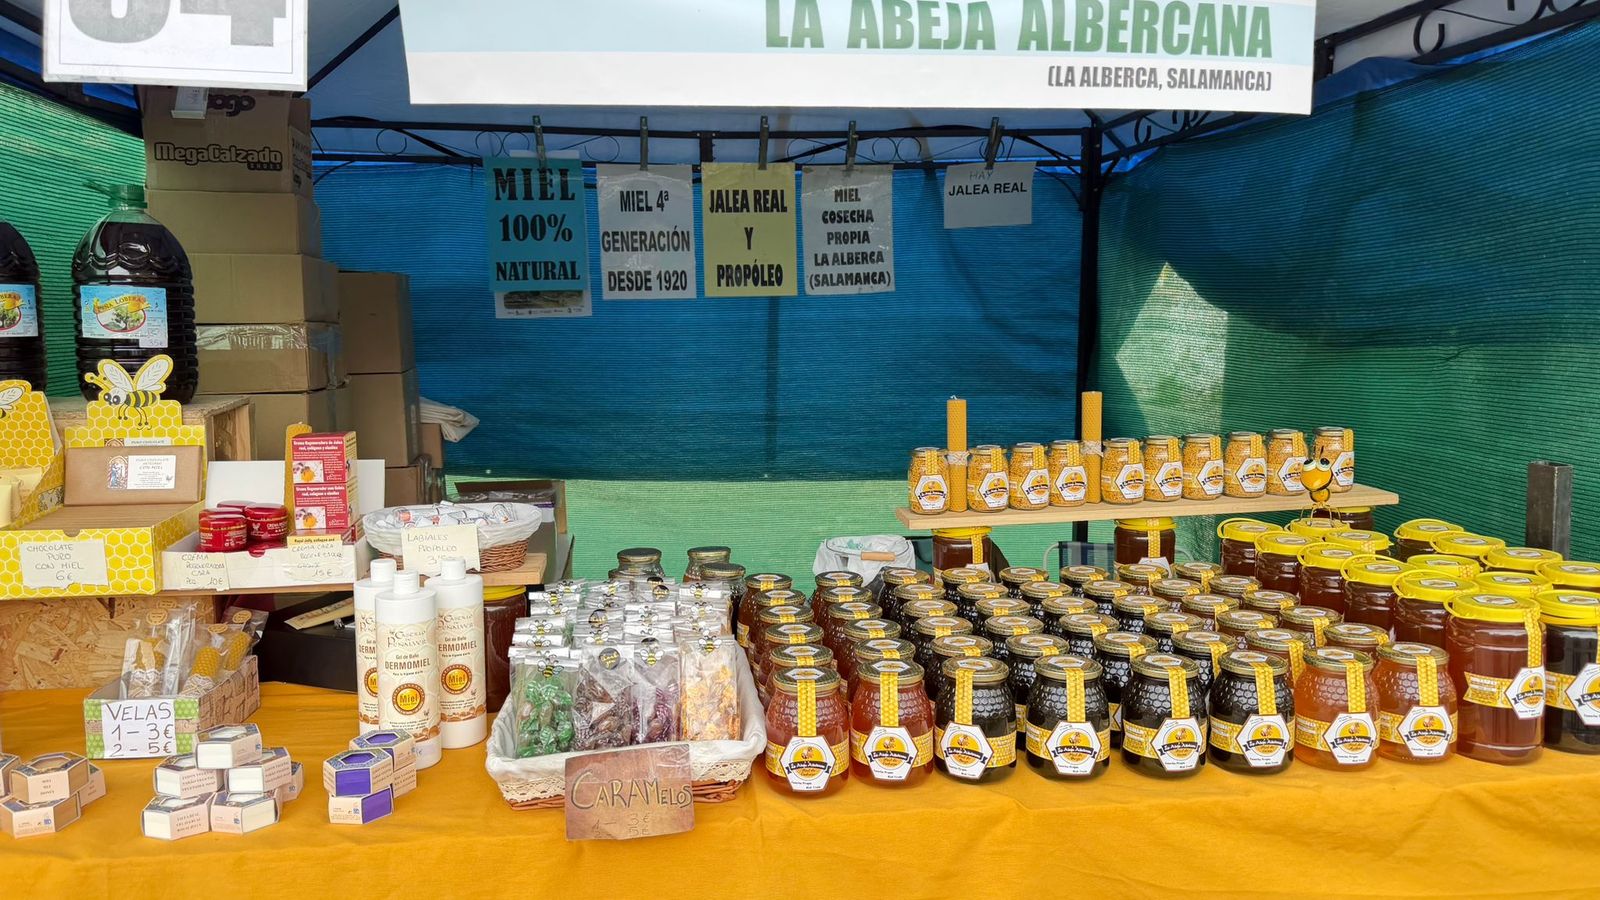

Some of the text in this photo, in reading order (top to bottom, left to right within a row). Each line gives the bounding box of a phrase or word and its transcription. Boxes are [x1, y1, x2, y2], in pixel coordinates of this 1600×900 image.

[766, 0, 1272, 58] LA ABEJA ALBERCANA
[1080, 67, 1162, 91] ALBERCA,
[1167, 68, 1271, 92] SALAMANCA)
[493, 168, 576, 200] MIEL
[948, 182, 1028, 196] JALEA REAL
[620, 190, 652, 212] MIEL
[710, 190, 788, 213] JALEA REAL
[834, 188, 862, 202] MIEL
[822, 209, 874, 224] COSECHA
[499, 213, 573, 242] 100%
[602, 225, 690, 252] GENERACIÓN
[744, 227, 754, 250] Y
[827, 230, 870, 244] PROPIA
[814, 251, 884, 266] LA ALBERCA
[496, 260, 580, 281] NATURAL
[716, 259, 784, 287] PROPÓLEO
[608, 270, 688, 292] DESDE 1920
[809, 271, 892, 290] (SALAMANCA)
[61, 562, 84, 570] MIEL
[438, 641, 477, 652] ERMOMIEL
[384, 658, 430, 670] DERMOMIEL
[400, 694, 418, 703] Miel
[104, 702, 172, 720] VELAS
[111, 724, 121, 742] 1
[109, 743, 124, 758] 2
